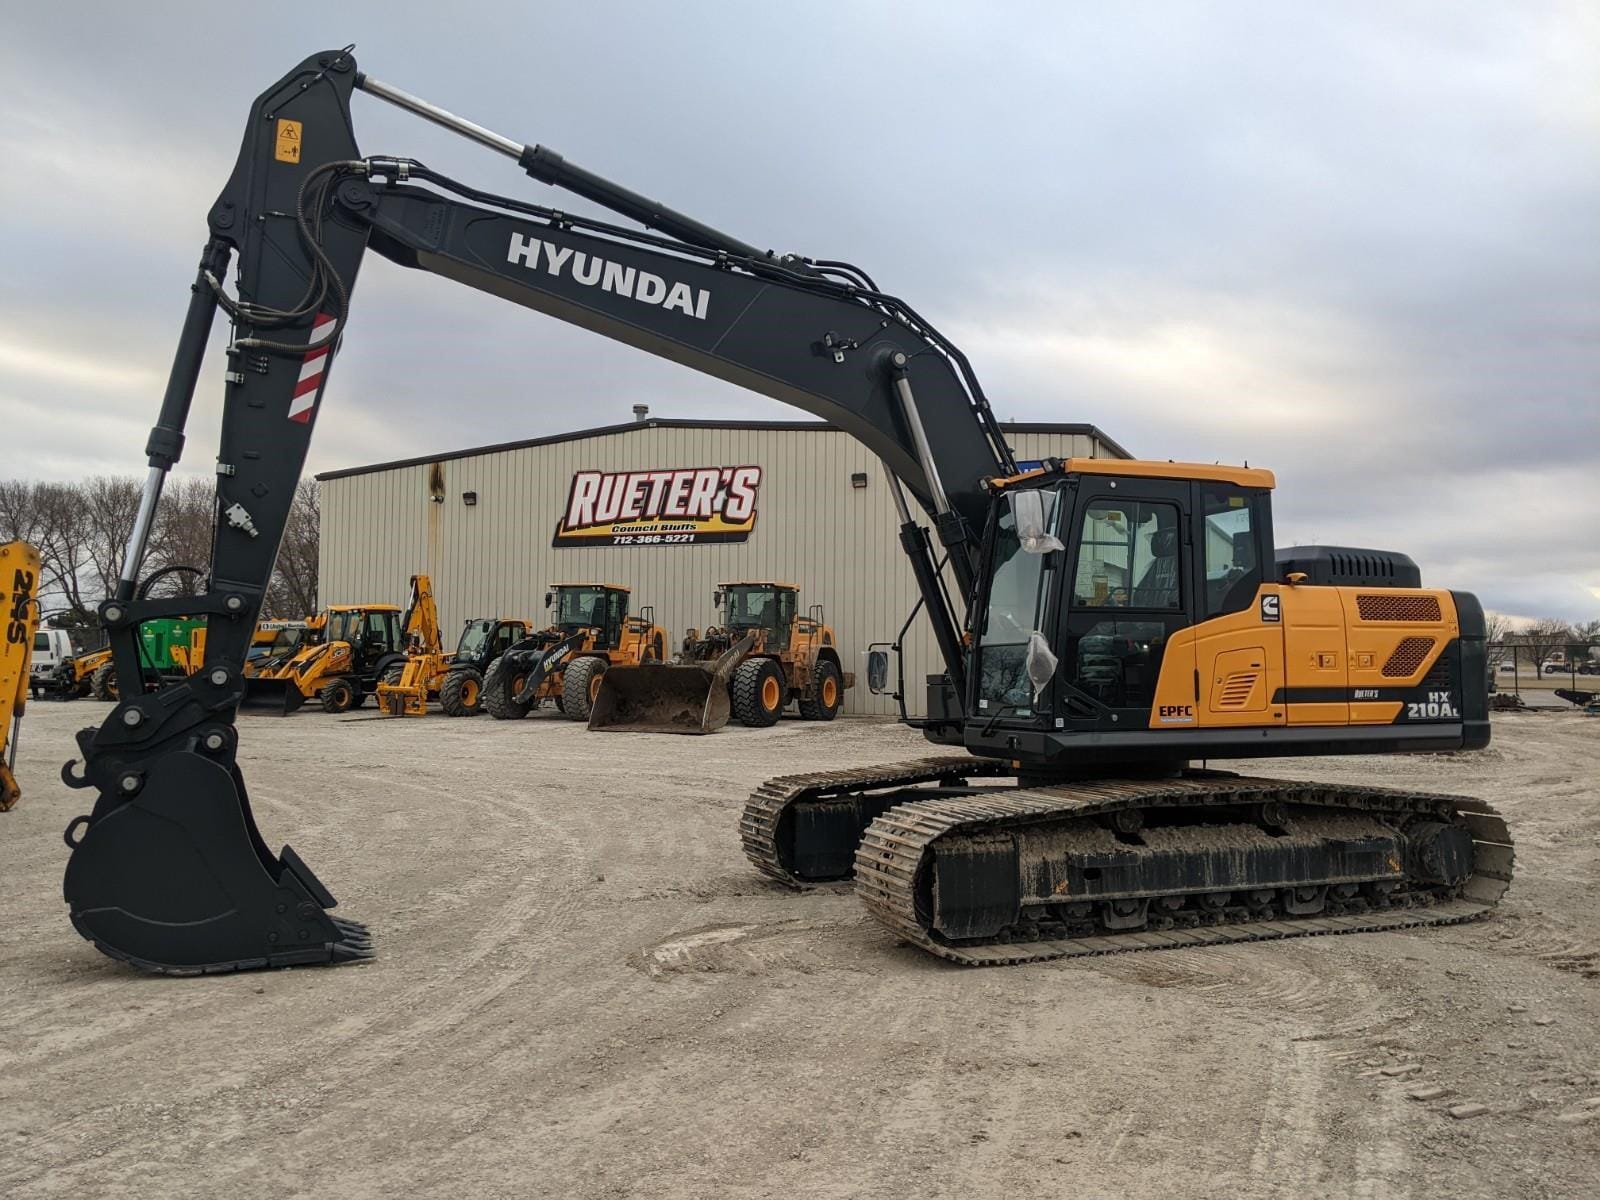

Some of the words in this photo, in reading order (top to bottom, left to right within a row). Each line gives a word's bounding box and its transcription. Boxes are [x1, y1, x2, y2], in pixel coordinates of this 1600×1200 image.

[507, 231, 711, 320] HYUNDAI
[567, 466, 761, 528] RUETER'S
[611, 523, 658, 533] Council
[660, 522, 697, 532] Bluffs
[613, 534, 695, 545] 712-366-5221
[543, 644, 570, 668] HYUNDAI
[1428, 692, 1449, 702] HX
[1160, 706, 1193, 717] EPFC
